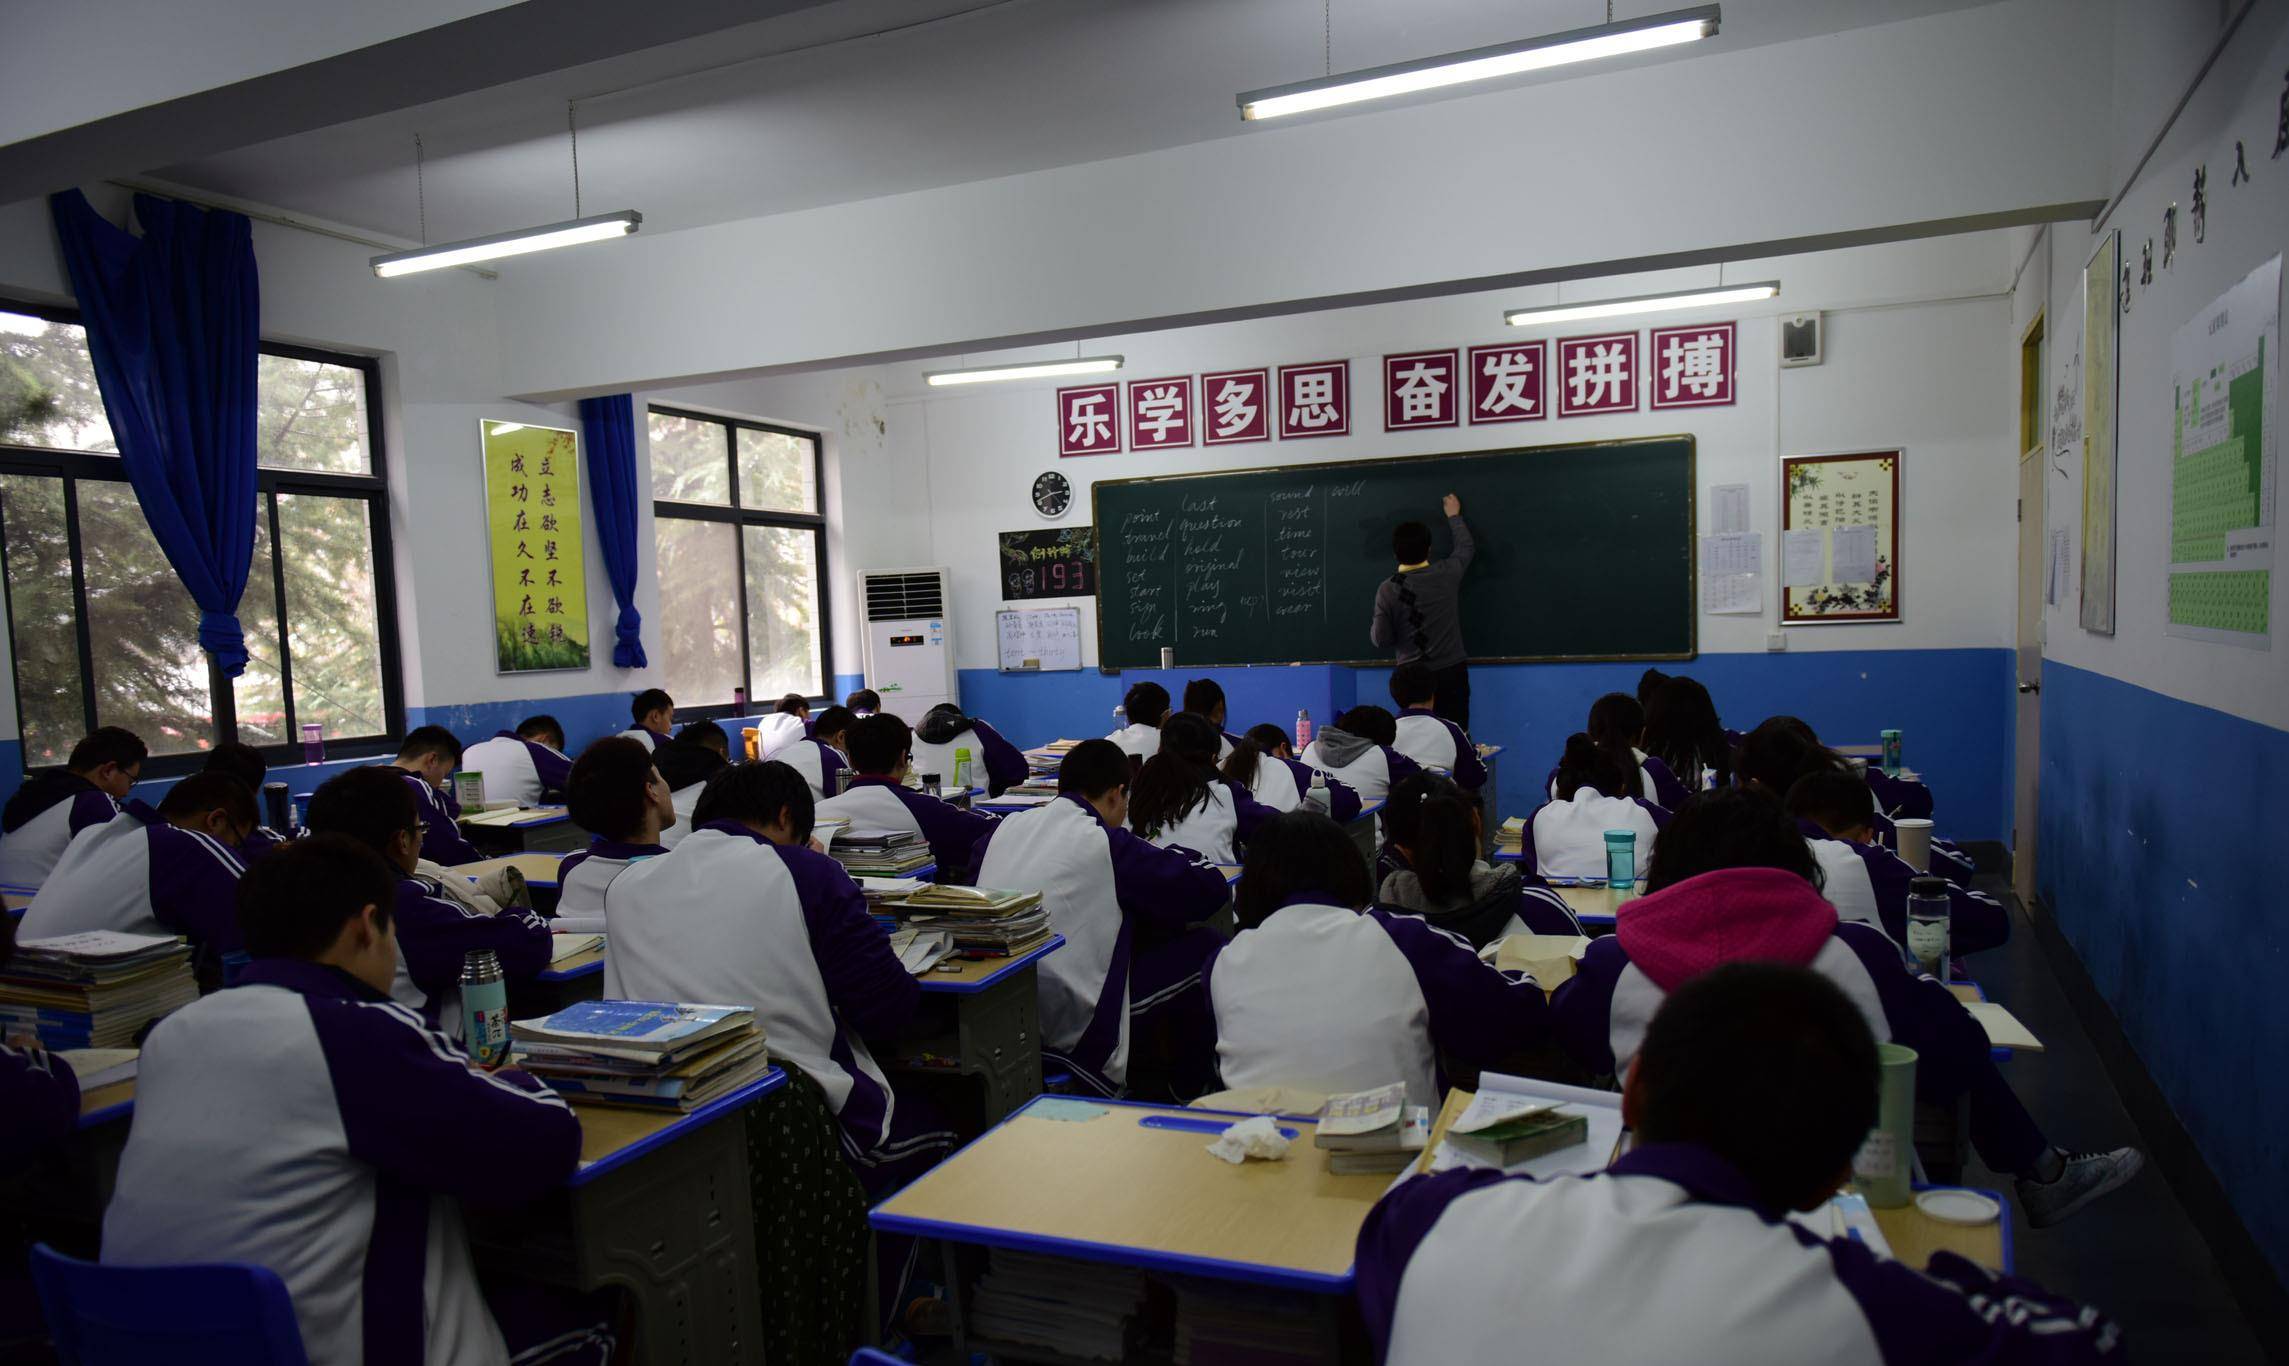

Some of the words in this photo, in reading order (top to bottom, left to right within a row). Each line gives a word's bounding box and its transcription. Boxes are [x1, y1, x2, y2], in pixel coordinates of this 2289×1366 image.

[1068, 372, 1341, 447] 乐学多思
[1394, 333, 1724, 421] 奋发拼搏
[1182, 494, 1216, 512] last
[1120, 511, 1160, 532] point
[1180, 518, 1241, 542] question
[538, 456, 567, 644] 立志欲坚不欲锐
[1126, 545, 1168, 563] build
[1041, 561, 1085, 591] 193
[1127, 570, 1145, 584] set
[1129, 614, 1164, 641] look
